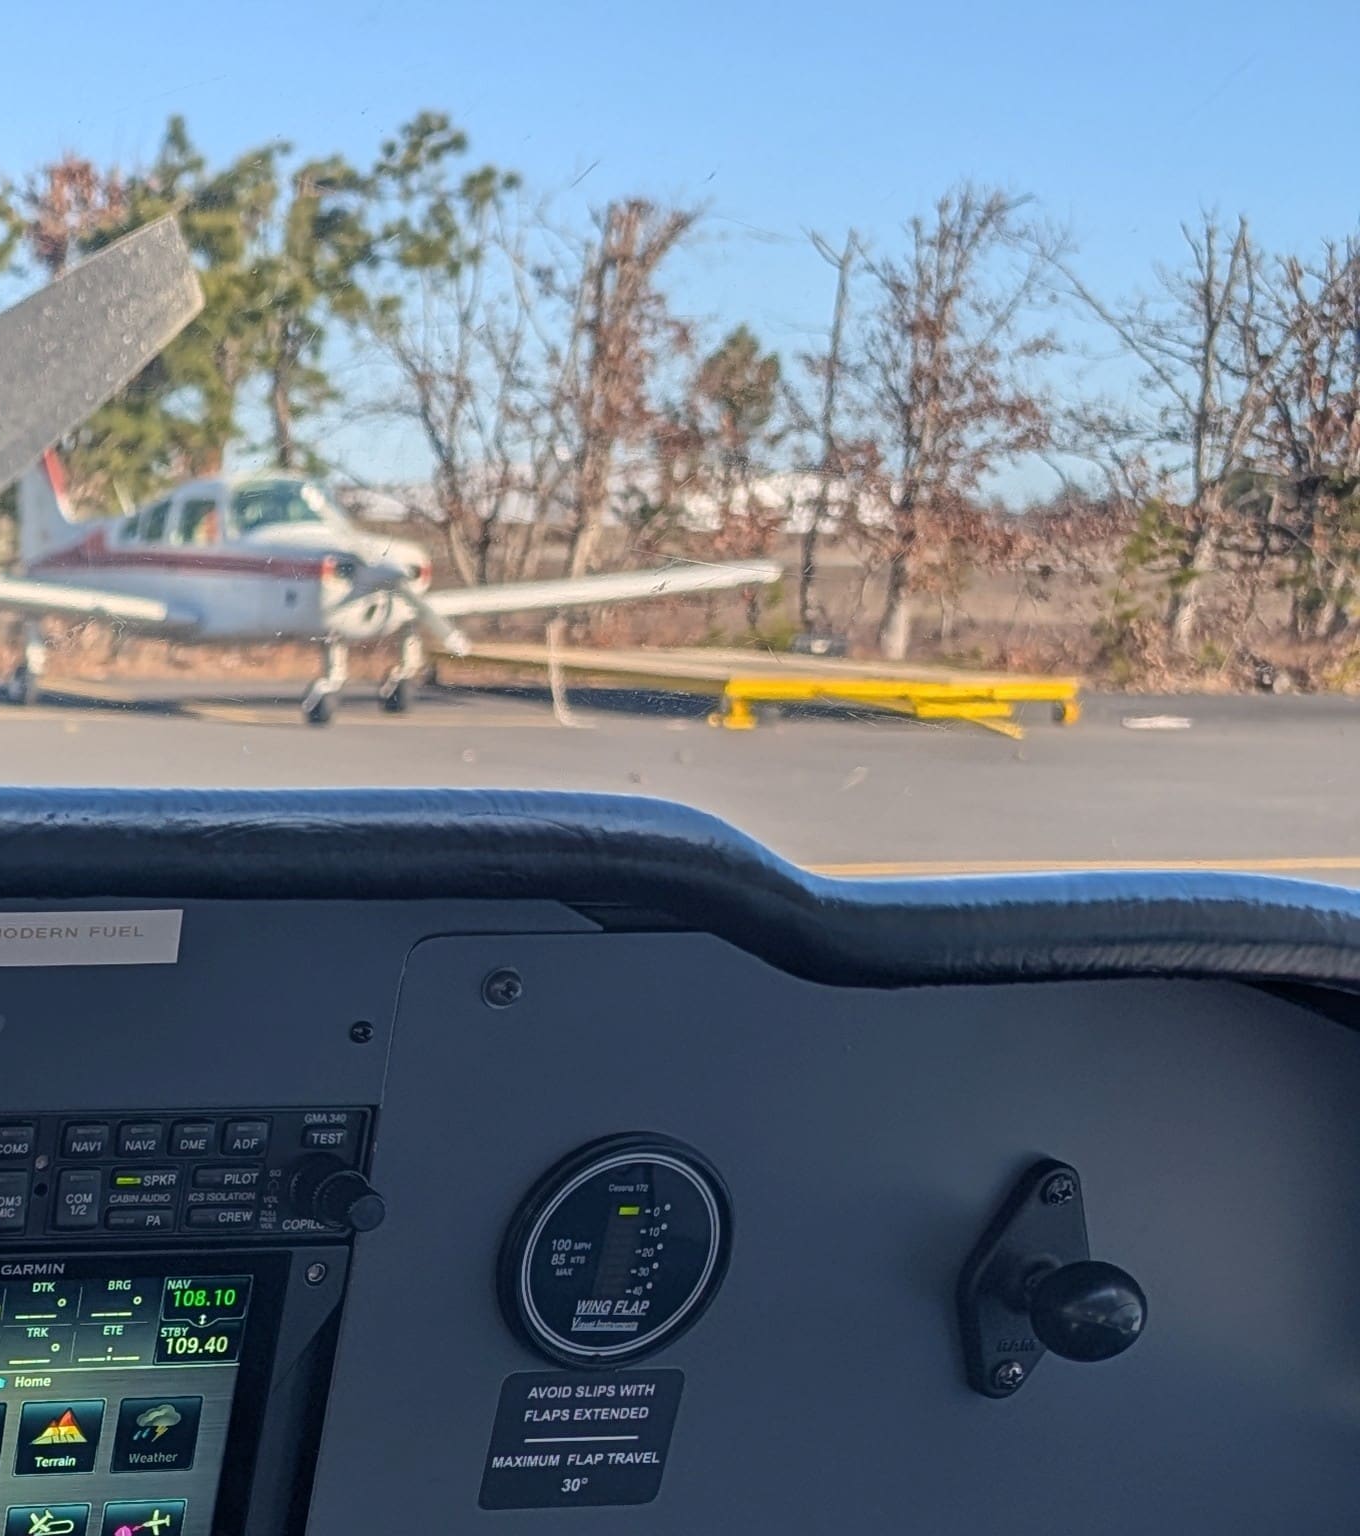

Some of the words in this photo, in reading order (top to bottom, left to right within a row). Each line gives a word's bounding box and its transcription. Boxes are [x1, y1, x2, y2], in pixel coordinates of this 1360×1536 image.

[89, 925, 144, 938] FUEL
[125, 1140, 156, 1151] NAV2
[233, 1139, 259, 1150] ADF
[312, 1133, 344, 1145] TEST
[143, 1174, 176, 1187] SPKR
[224, 1172, 259, 1185] PILOT
[218, 1212, 253, 1223] CREW
[0, 1263, 65, 1276] GARMIN
[172, 1289, 236, 1307] 108.10
[164, 1336, 228, 1355] 109.40
[14, 1375, 51, 1389] Home
[528, 1385, 572, 1399] AVOID
[575, 1385, 616, 1398] SLIPS
[619, 1383, 656, 1397] WITH
[524, 1408, 570, 1422] FLAPS
[573, 1406, 649, 1420] EXTENDED
[34, 1454, 76, 1469] Terrain
[128, 1450, 178, 1465] Weather
[491, 1453, 560, 1468] MAXIMUM
[566, 1453, 604, 1466] FLAP
[607, 1451, 660, 1464] TRAVEL
